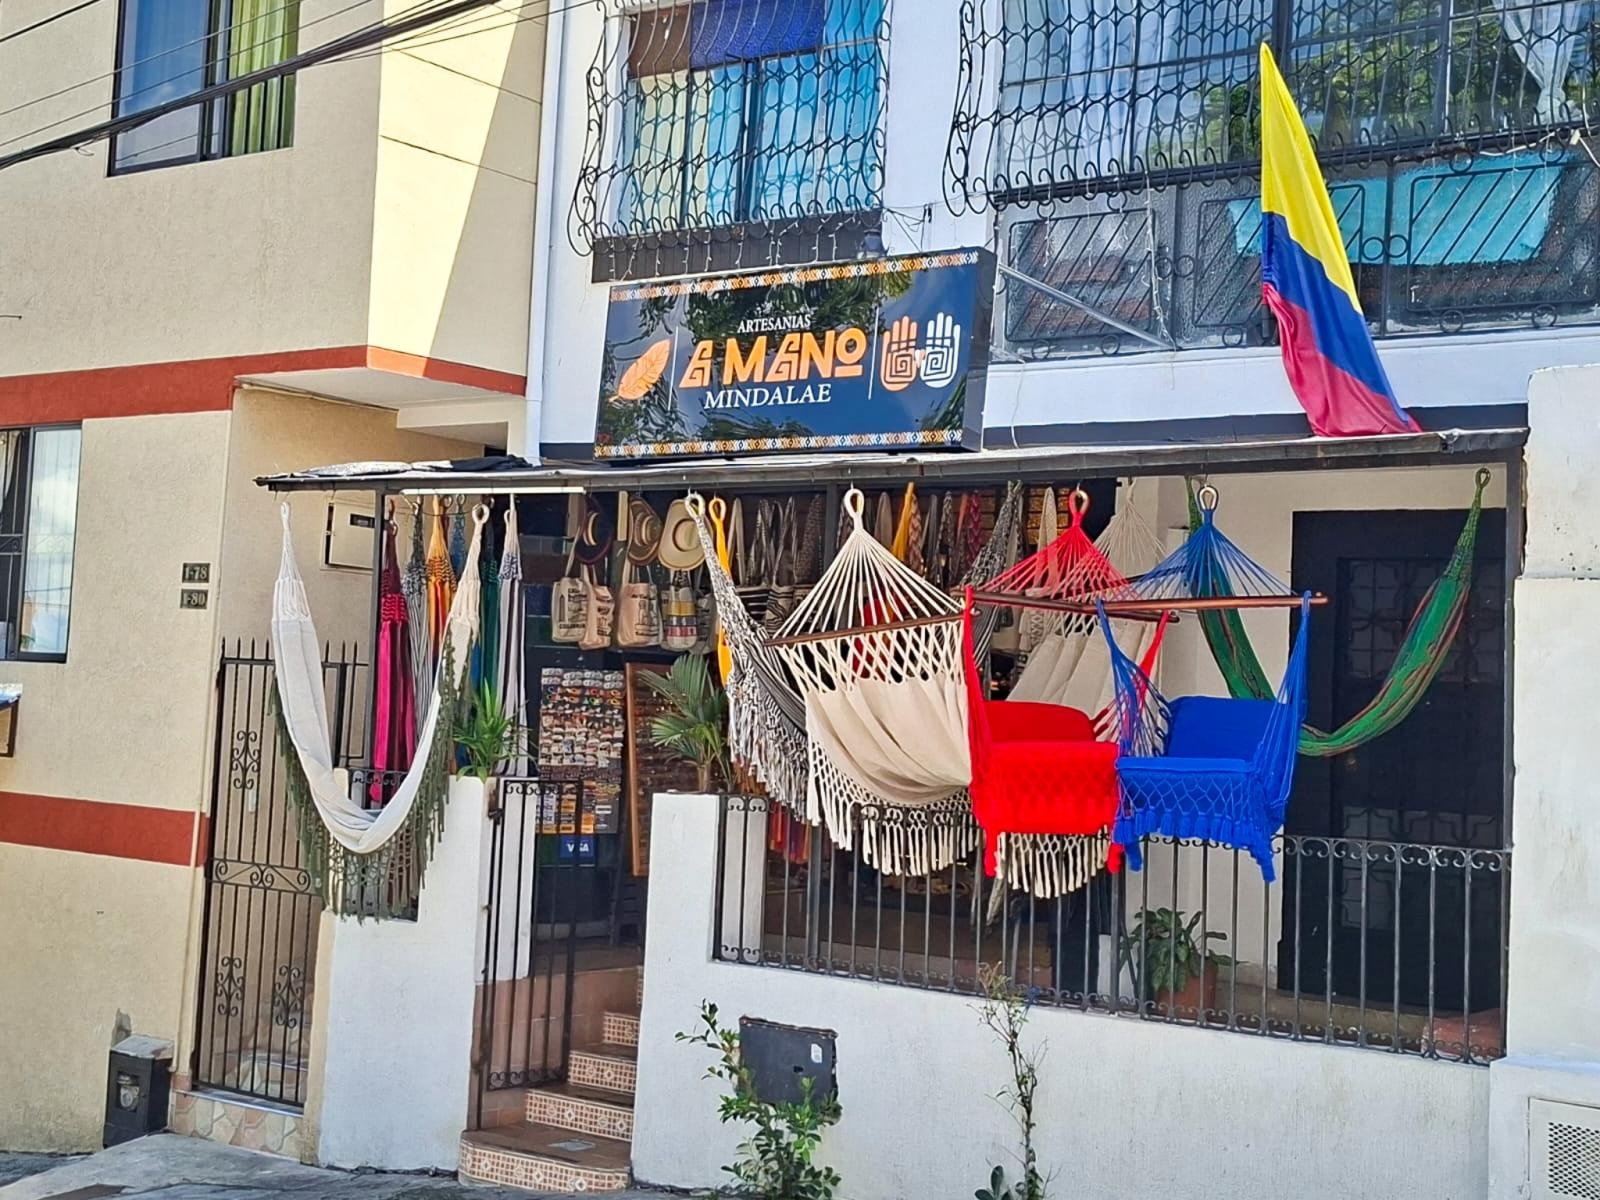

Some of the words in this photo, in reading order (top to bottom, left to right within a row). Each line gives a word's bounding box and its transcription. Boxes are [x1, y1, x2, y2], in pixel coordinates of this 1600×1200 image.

[737, 313, 812, 334] ARTESANIAS
[679, 340, 714, 388] A
[723, 327, 867, 385] MANO
[704, 383, 832, 409] MINDALAE
